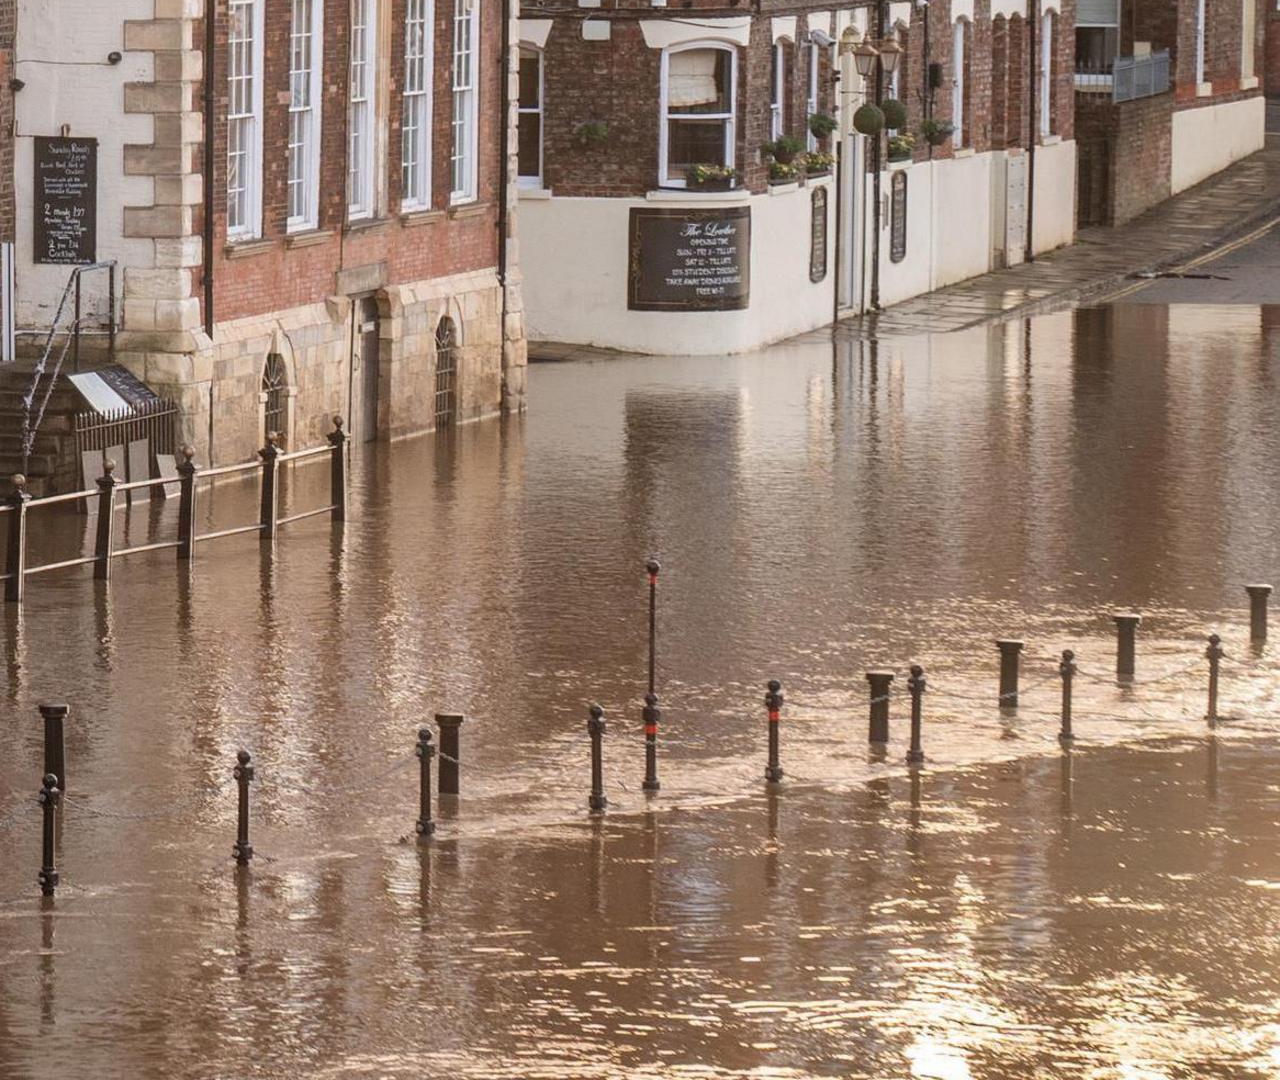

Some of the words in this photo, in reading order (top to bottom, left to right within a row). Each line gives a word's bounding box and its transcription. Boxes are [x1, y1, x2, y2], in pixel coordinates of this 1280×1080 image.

[44, 203, 51, 215] 2
[680, 223, 702, 236] The
[704, 222, 736, 236] Lowther
[685, 268, 715, 276] STUDENT
